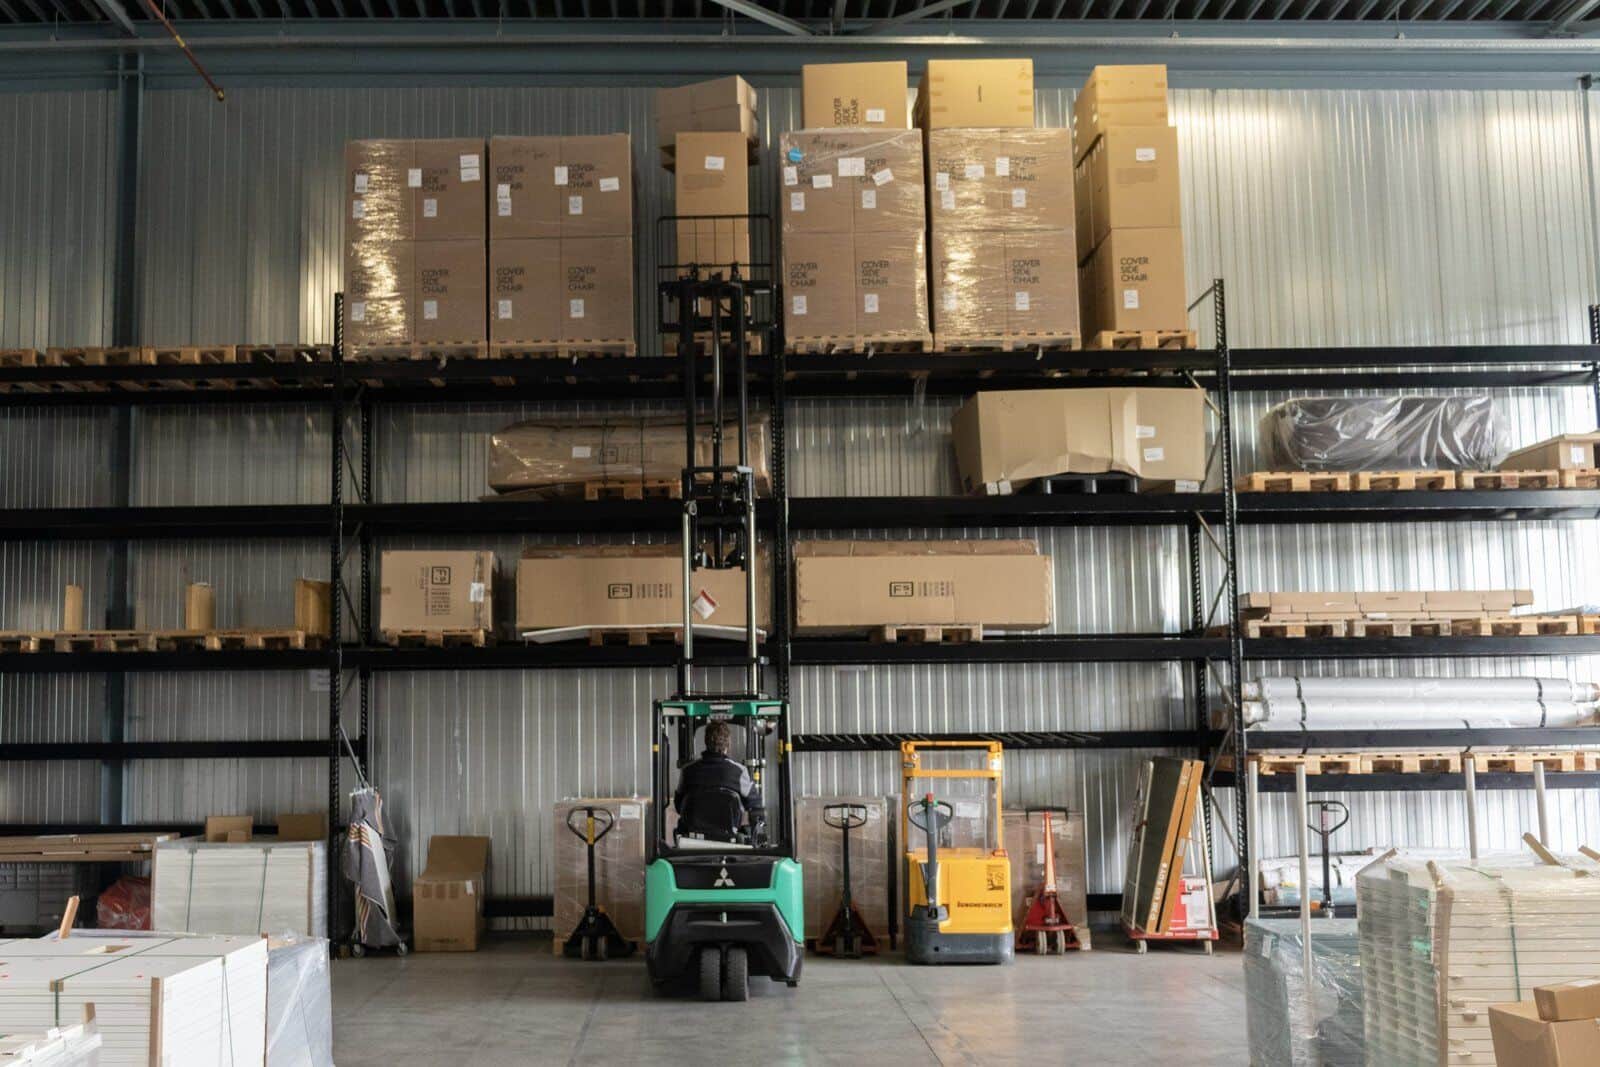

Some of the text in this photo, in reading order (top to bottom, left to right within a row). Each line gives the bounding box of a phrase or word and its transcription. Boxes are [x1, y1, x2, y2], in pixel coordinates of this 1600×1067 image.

[833, 97, 841, 125] COVER
[567, 163, 594, 171] COVER
[861, 260, 889, 268] COVER
[1012, 259, 1040, 267] COVER
[1120, 256, 1148, 265] COVER
[790, 262, 817, 270] COVER
[496, 267, 524, 275] COVER
[790, 279, 816, 287] CHAIR
[861, 278, 888, 286] CHAIR
[1012, 276, 1039, 284] CHAIR
[496, 284, 522, 292] CHAIR
[568, 282, 594, 290] CHAIR
